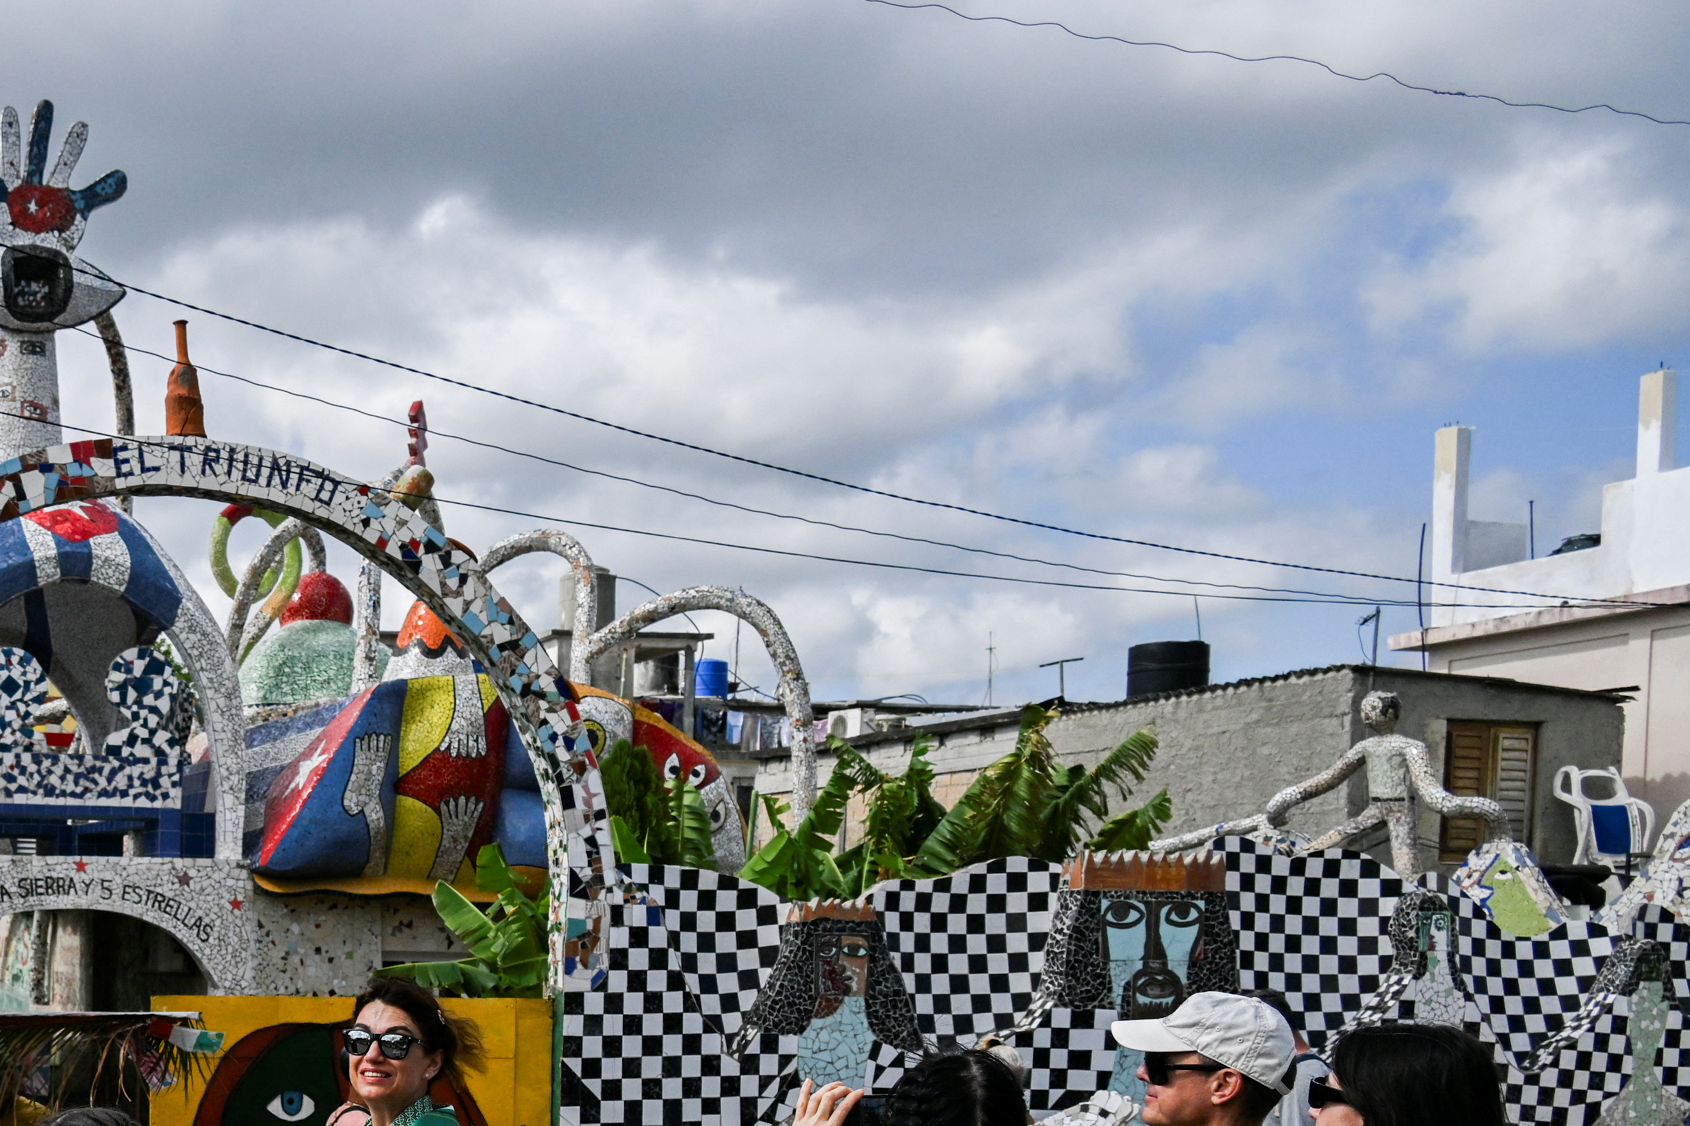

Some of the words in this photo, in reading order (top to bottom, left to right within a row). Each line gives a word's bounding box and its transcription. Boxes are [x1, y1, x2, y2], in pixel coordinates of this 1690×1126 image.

[112, 444, 162, 478] EL
[168, 445, 342, 506] TRIUNFO
[18, 876, 78, 899] SIERRA
[81, 878, 96, 896] Y
[100, 879, 114, 900] 5
[121, 884, 215, 943] ESTRELLAS
